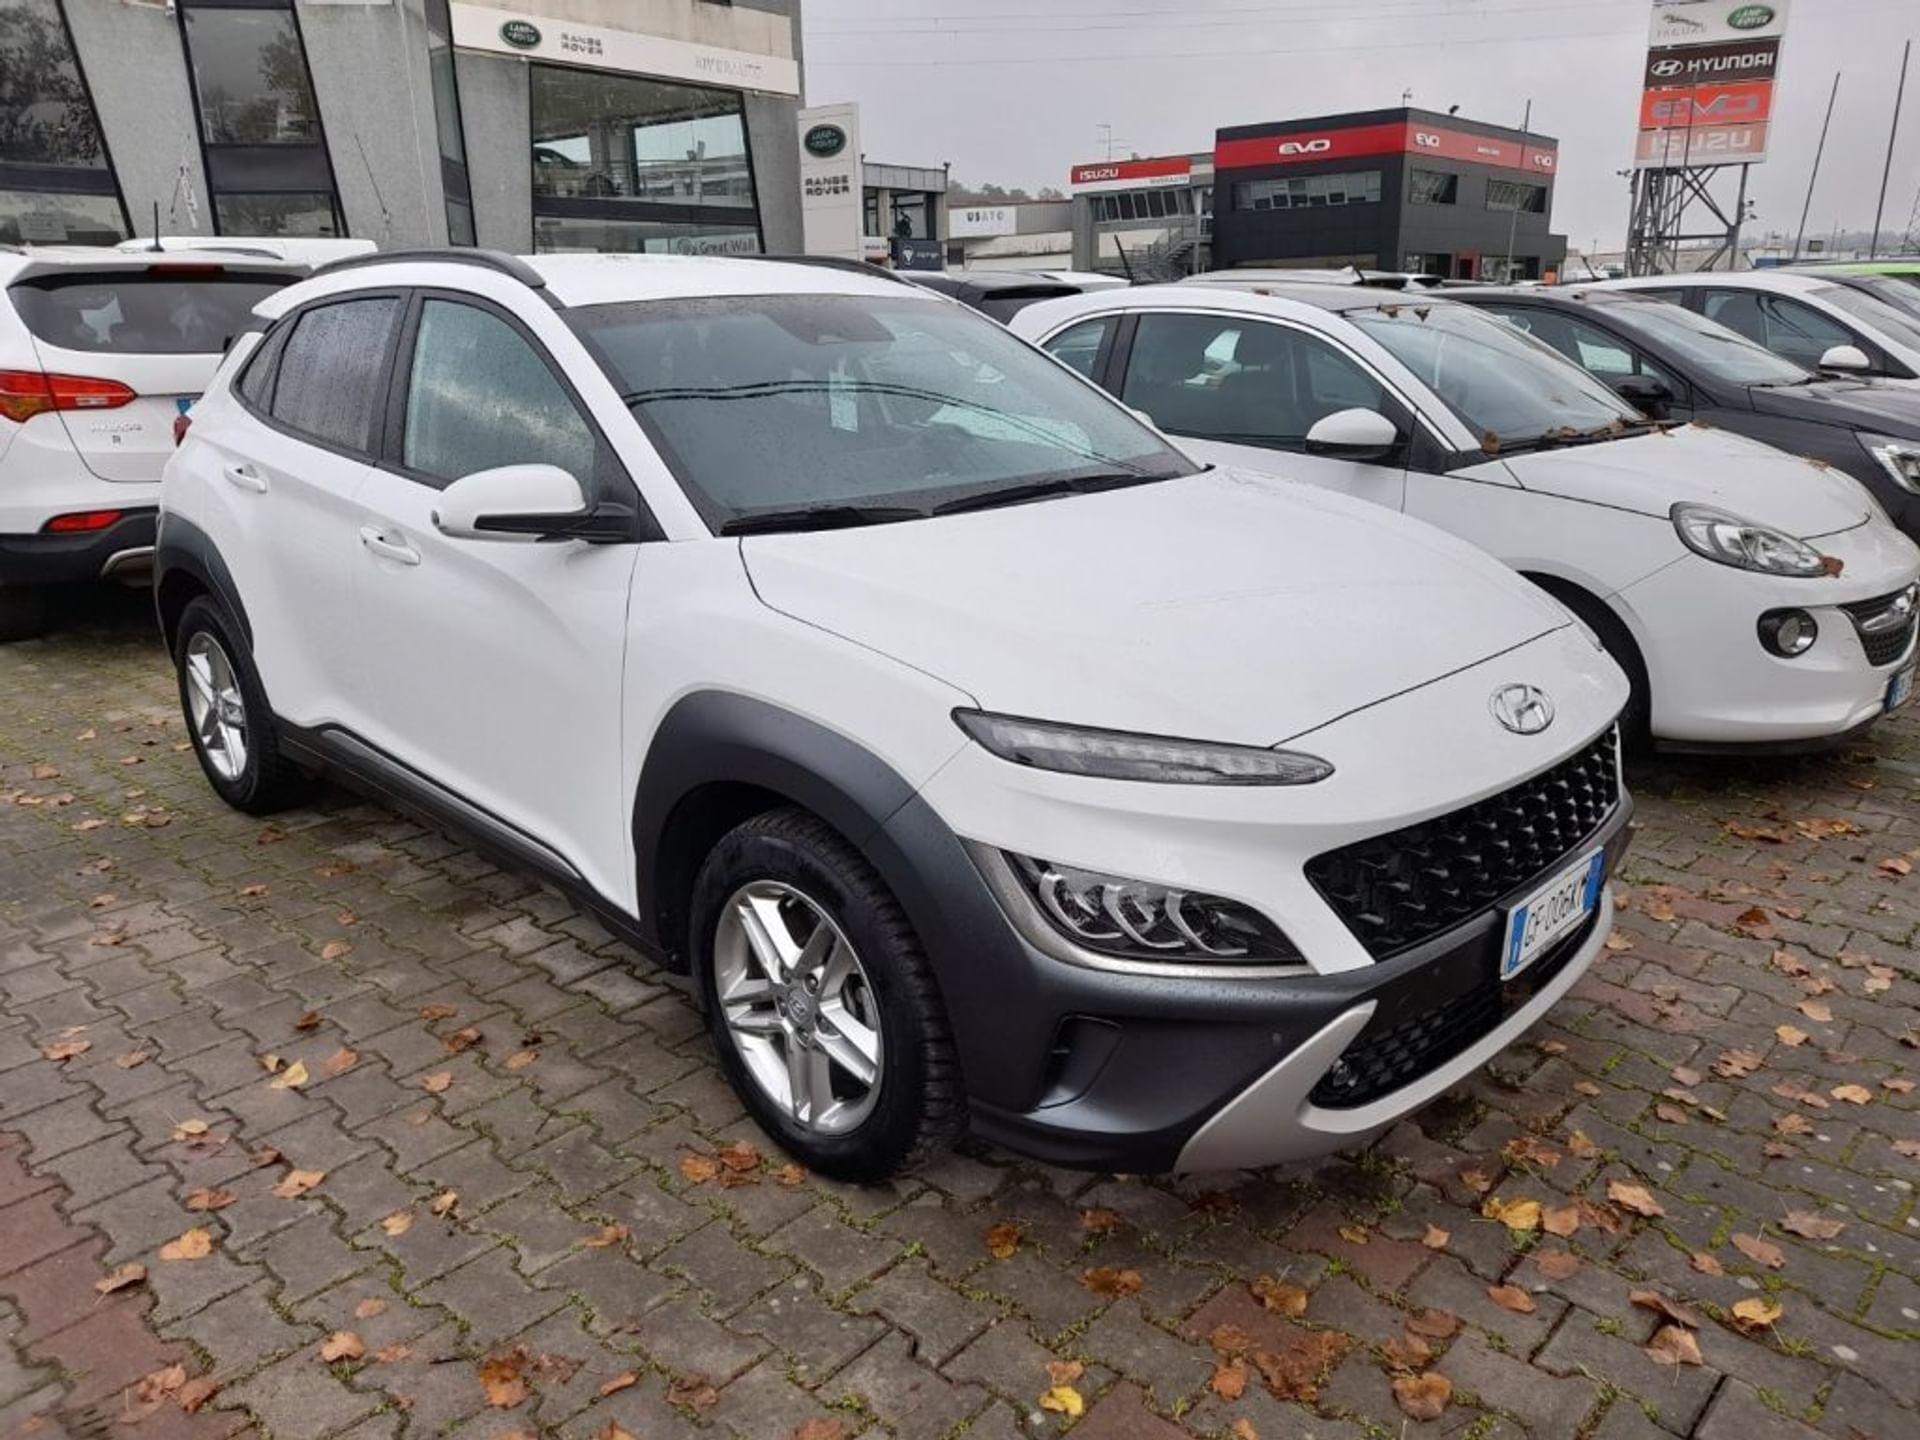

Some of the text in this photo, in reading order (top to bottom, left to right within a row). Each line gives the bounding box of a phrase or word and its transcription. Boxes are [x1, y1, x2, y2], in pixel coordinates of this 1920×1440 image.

[561, 33, 601, 46] RANGE
[561, 42, 603, 54] ROVER
[1687, 52, 1774, 73] HYUNDAI
[1653, 95, 1760, 119] EVO
[1415, 132, 1440, 147] EVO
[1652, 130, 1752, 153] ISUZU
[1279, 139, 1331, 155] EVO
[804, 175, 849, 186] RANGE
[1080, 167, 1119, 181] ISUZU
[805, 185, 850, 197] ROVER
[966, 210, 1005, 223] USATO
[729, 237, 756, 252] Wall
